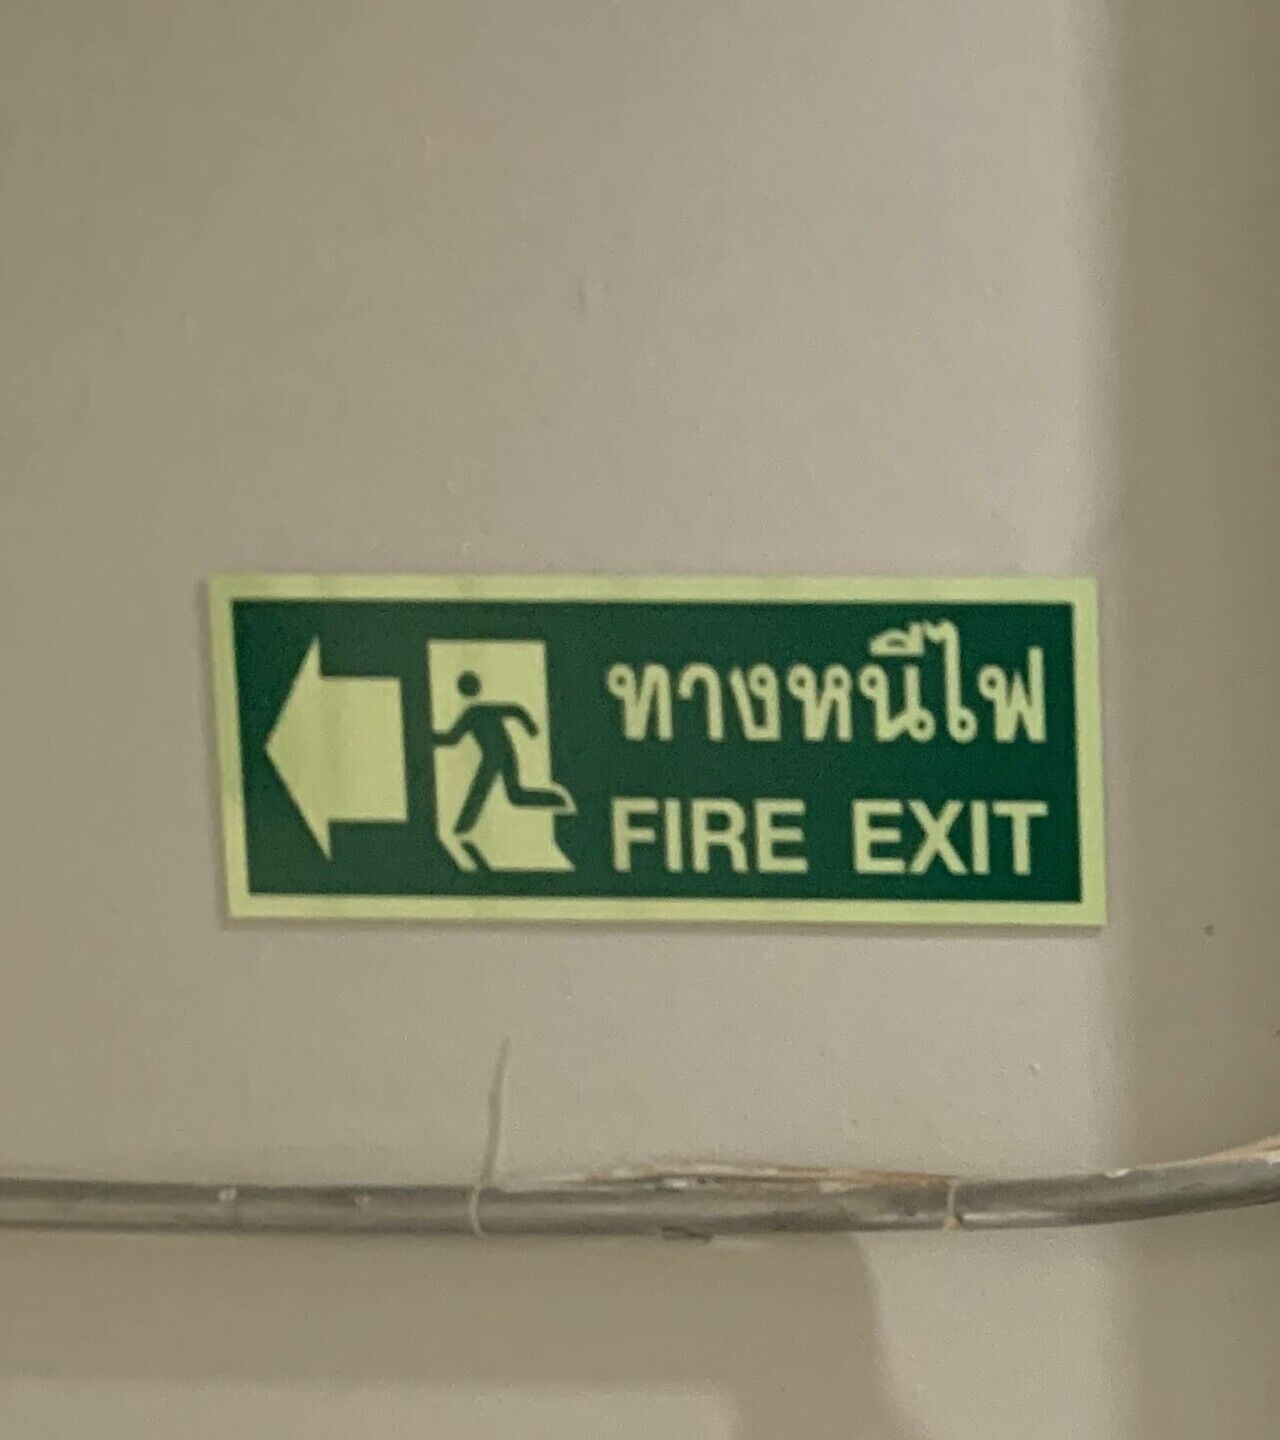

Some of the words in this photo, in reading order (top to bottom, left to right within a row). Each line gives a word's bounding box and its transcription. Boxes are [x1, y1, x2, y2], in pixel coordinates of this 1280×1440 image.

[607, 618, 1047, 743] ทางหนีไฟ
[611, 796, 809, 874] FIRE
[852, 798, 1049, 877] EXIT
